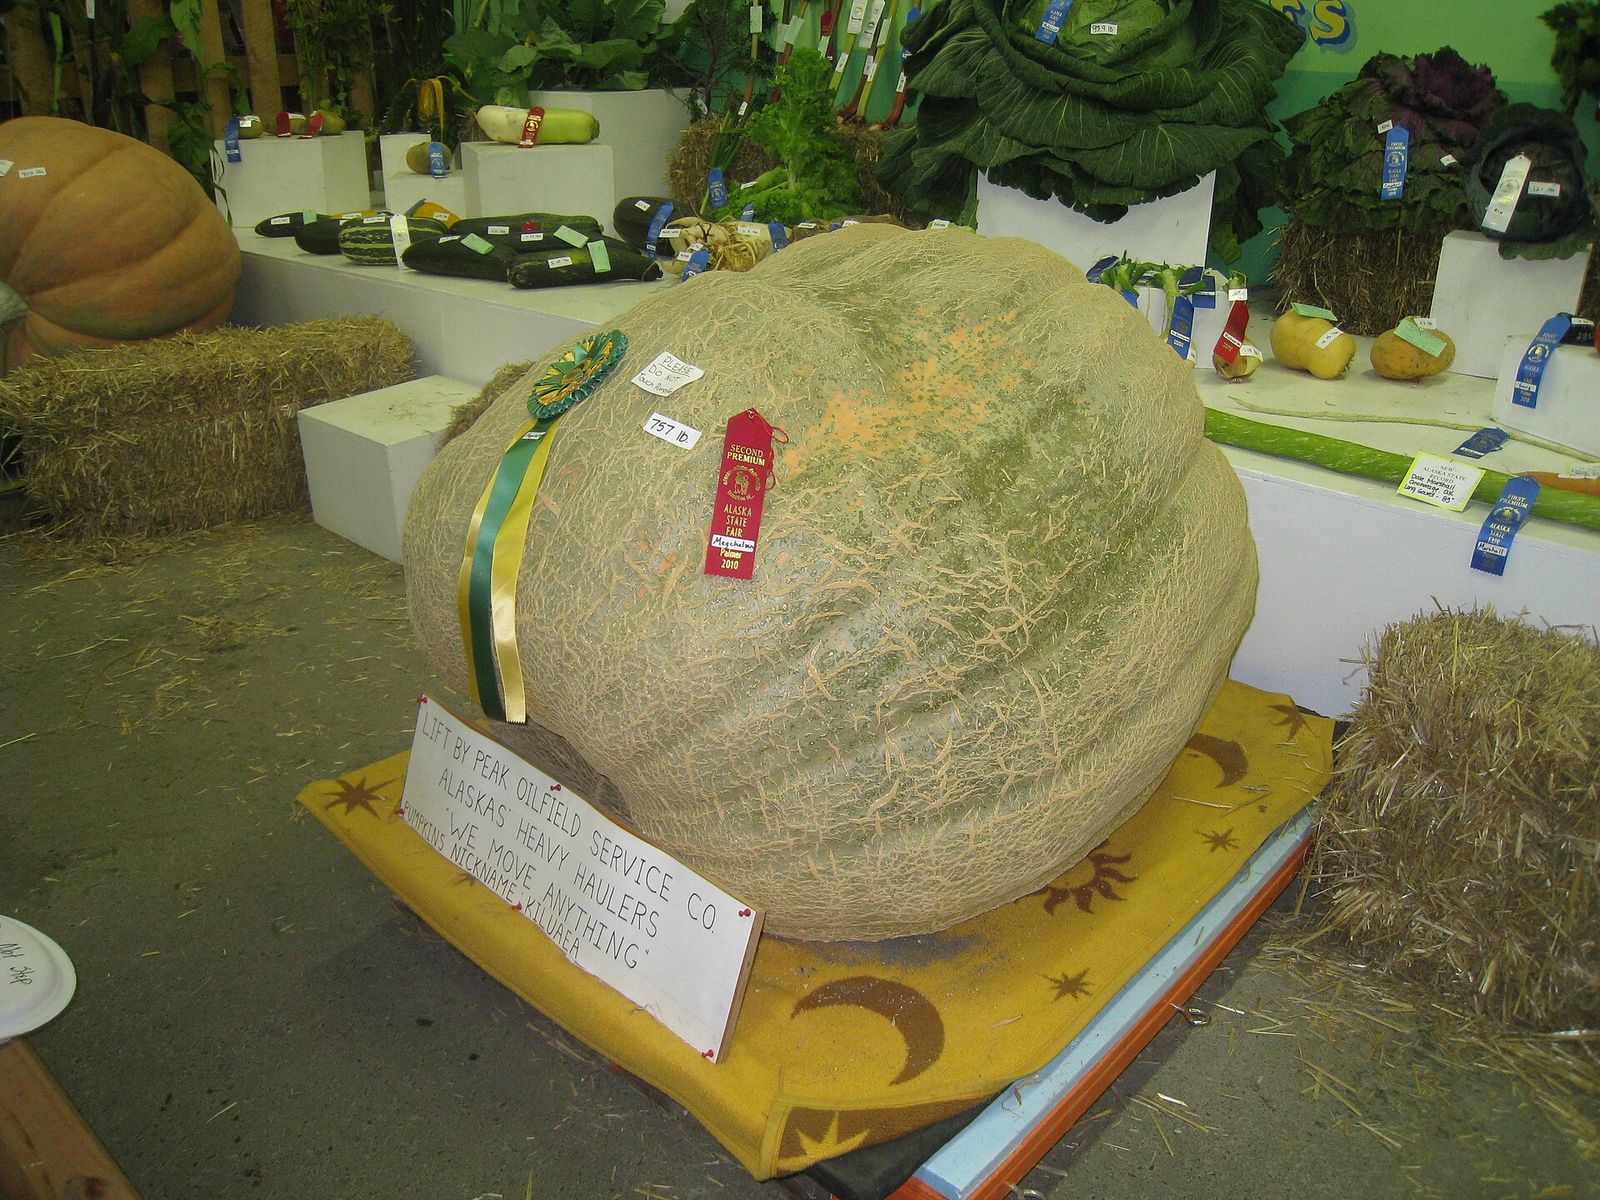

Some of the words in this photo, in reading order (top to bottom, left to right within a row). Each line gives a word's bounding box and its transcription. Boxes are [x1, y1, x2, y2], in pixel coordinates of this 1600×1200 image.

[661, 355, 694, 375] PLEASE
[650, 418, 675, 435] 757
[730, 444, 764, 458] SECOND
[727, 451, 766, 466] PREMIUM
[1507, 494, 1527, 502] FIRST
[723, 504, 753, 517] ALASKA
[726, 515, 748, 527] STATE
[1489, 523, 1511, 533] ALASKA
[726, 526, 744, 538] FAIR
[721, 558, 739, 570] 2010
[422, 711, 452, 750] LIFT
[453, 736, 471, 765] BY
[473, 750, 510, 790] PEAK
[516, 777, 582, 839] OILFIELD
[589, 830, 674, 903] SERVICE
[487, 839, 537, 890] MOVE
[404, 800, 446, 851] PUMPKINS
[524, 896, 580, 959] KILUAEA
[516, 818, 570, 871] HEAVY
[574, 863, 659, 938] HAULERS
